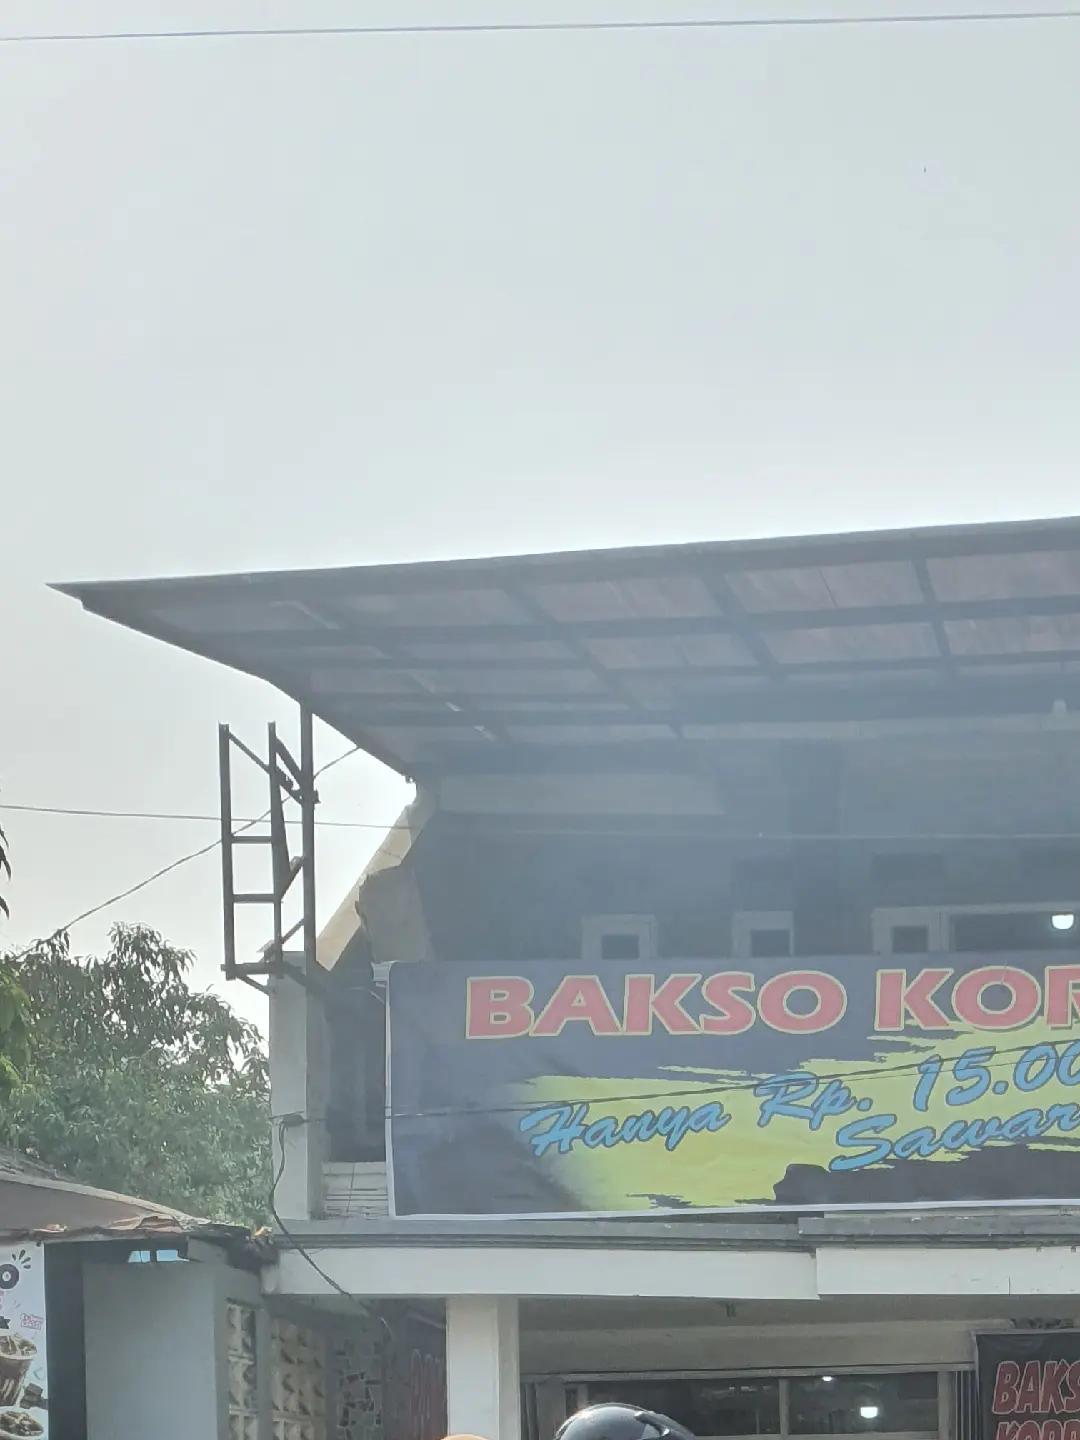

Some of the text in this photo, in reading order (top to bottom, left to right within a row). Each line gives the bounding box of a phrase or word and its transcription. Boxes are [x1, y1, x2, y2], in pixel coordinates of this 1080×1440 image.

[466, 970, 847, 1039] BAKSO
[518, 1100, 731, 1157] Hanya
[754, 1073, 873, 1130] Rp.
